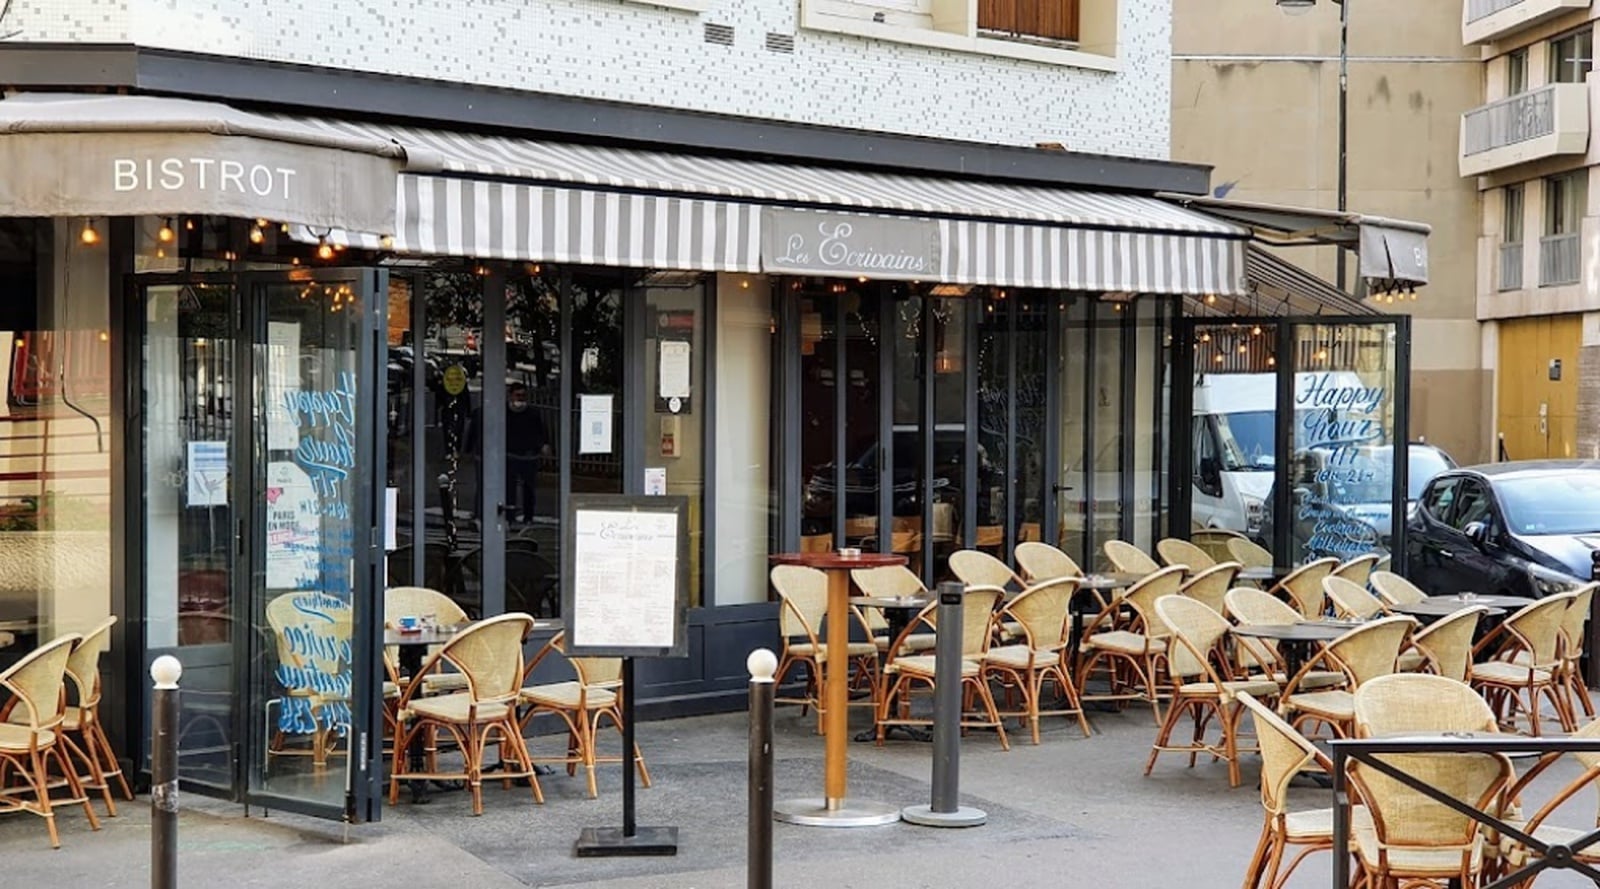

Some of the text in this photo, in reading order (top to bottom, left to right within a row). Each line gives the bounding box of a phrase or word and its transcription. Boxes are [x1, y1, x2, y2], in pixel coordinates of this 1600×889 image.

[113, 158, 296, 199] BISTROT
[776, 221, 929, 272] Les Ecrivains
[1296, 373, 1384, 414] Happy
[1329, 446, 1359, 467] 7/7
